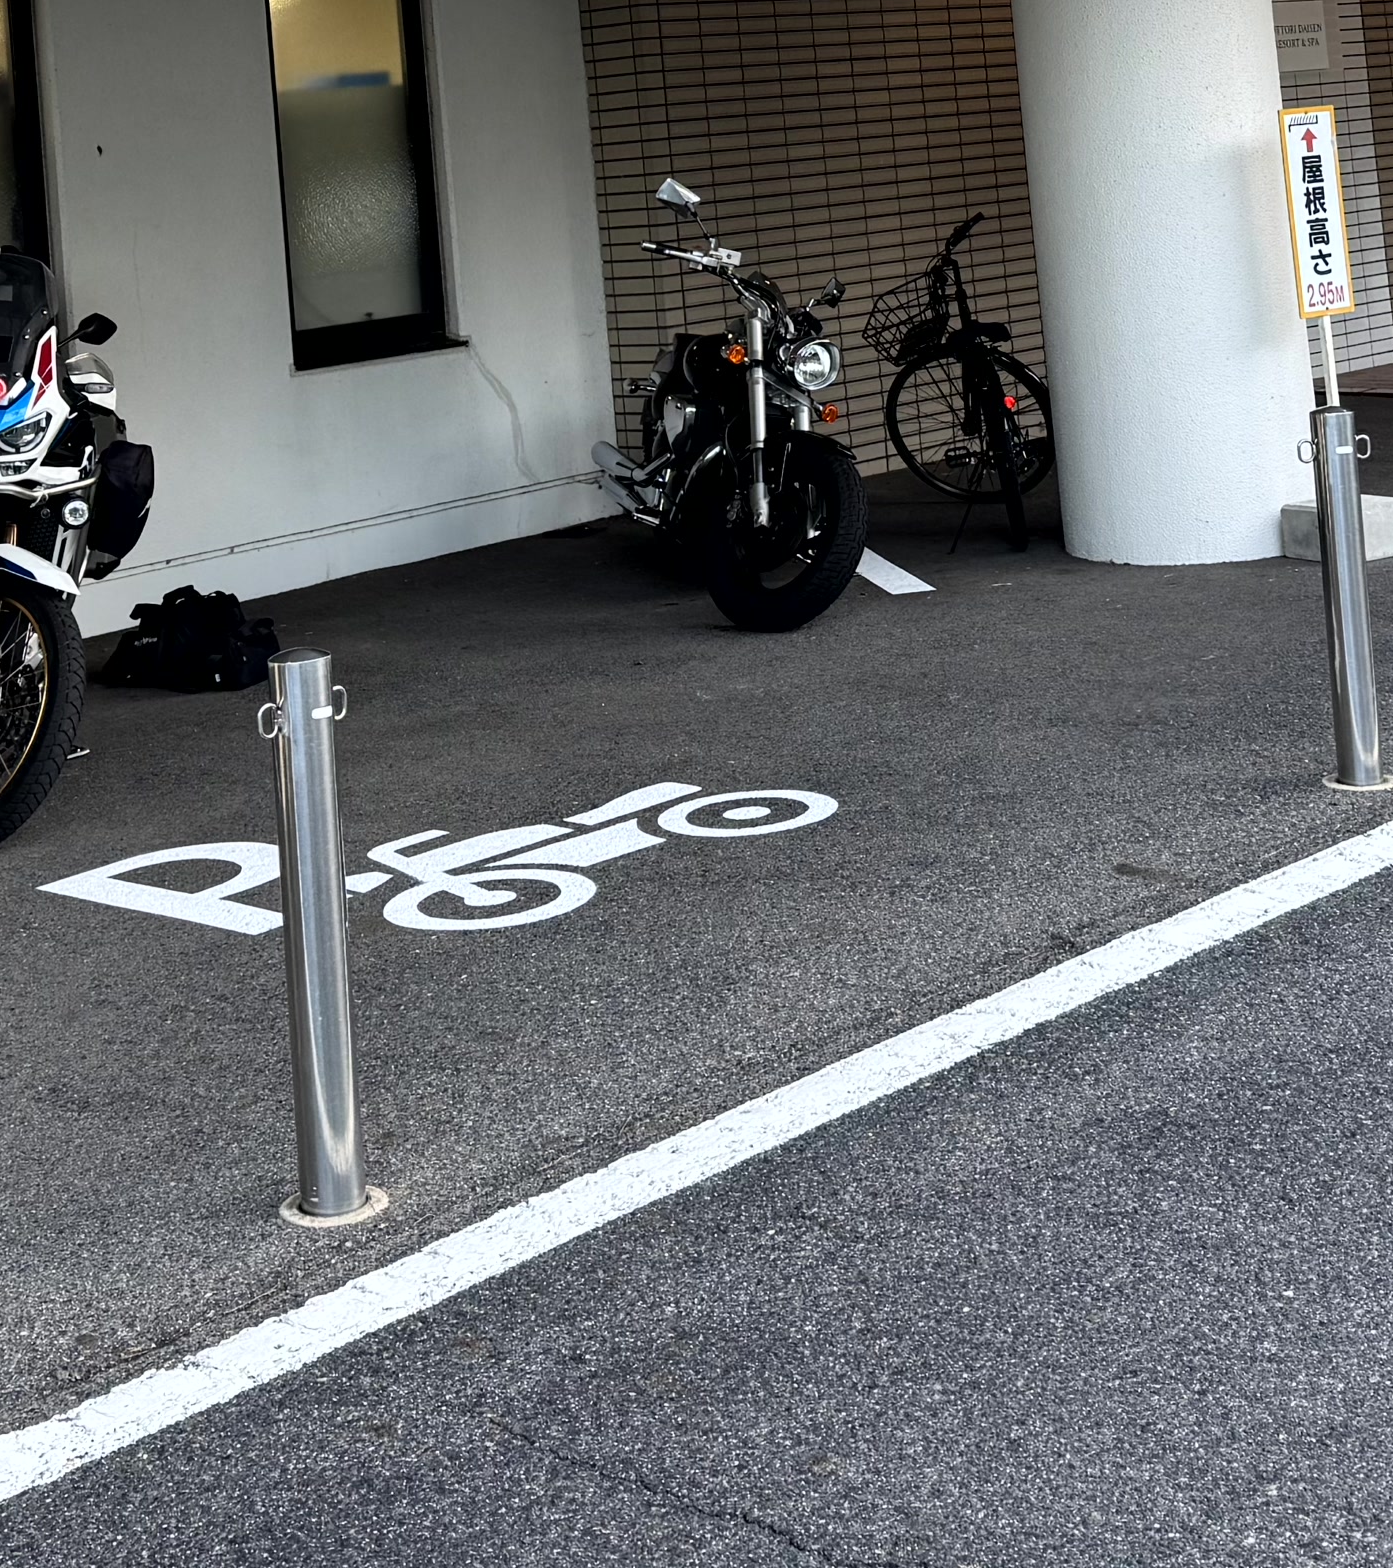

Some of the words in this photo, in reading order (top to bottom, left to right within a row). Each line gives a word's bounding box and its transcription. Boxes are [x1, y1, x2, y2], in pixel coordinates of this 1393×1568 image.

[1274, 24, 1297, 35] TTORI
[1276, 38, 1300, 49] ESORT
[1302, 154, 1332, 276] 屋根高さ
